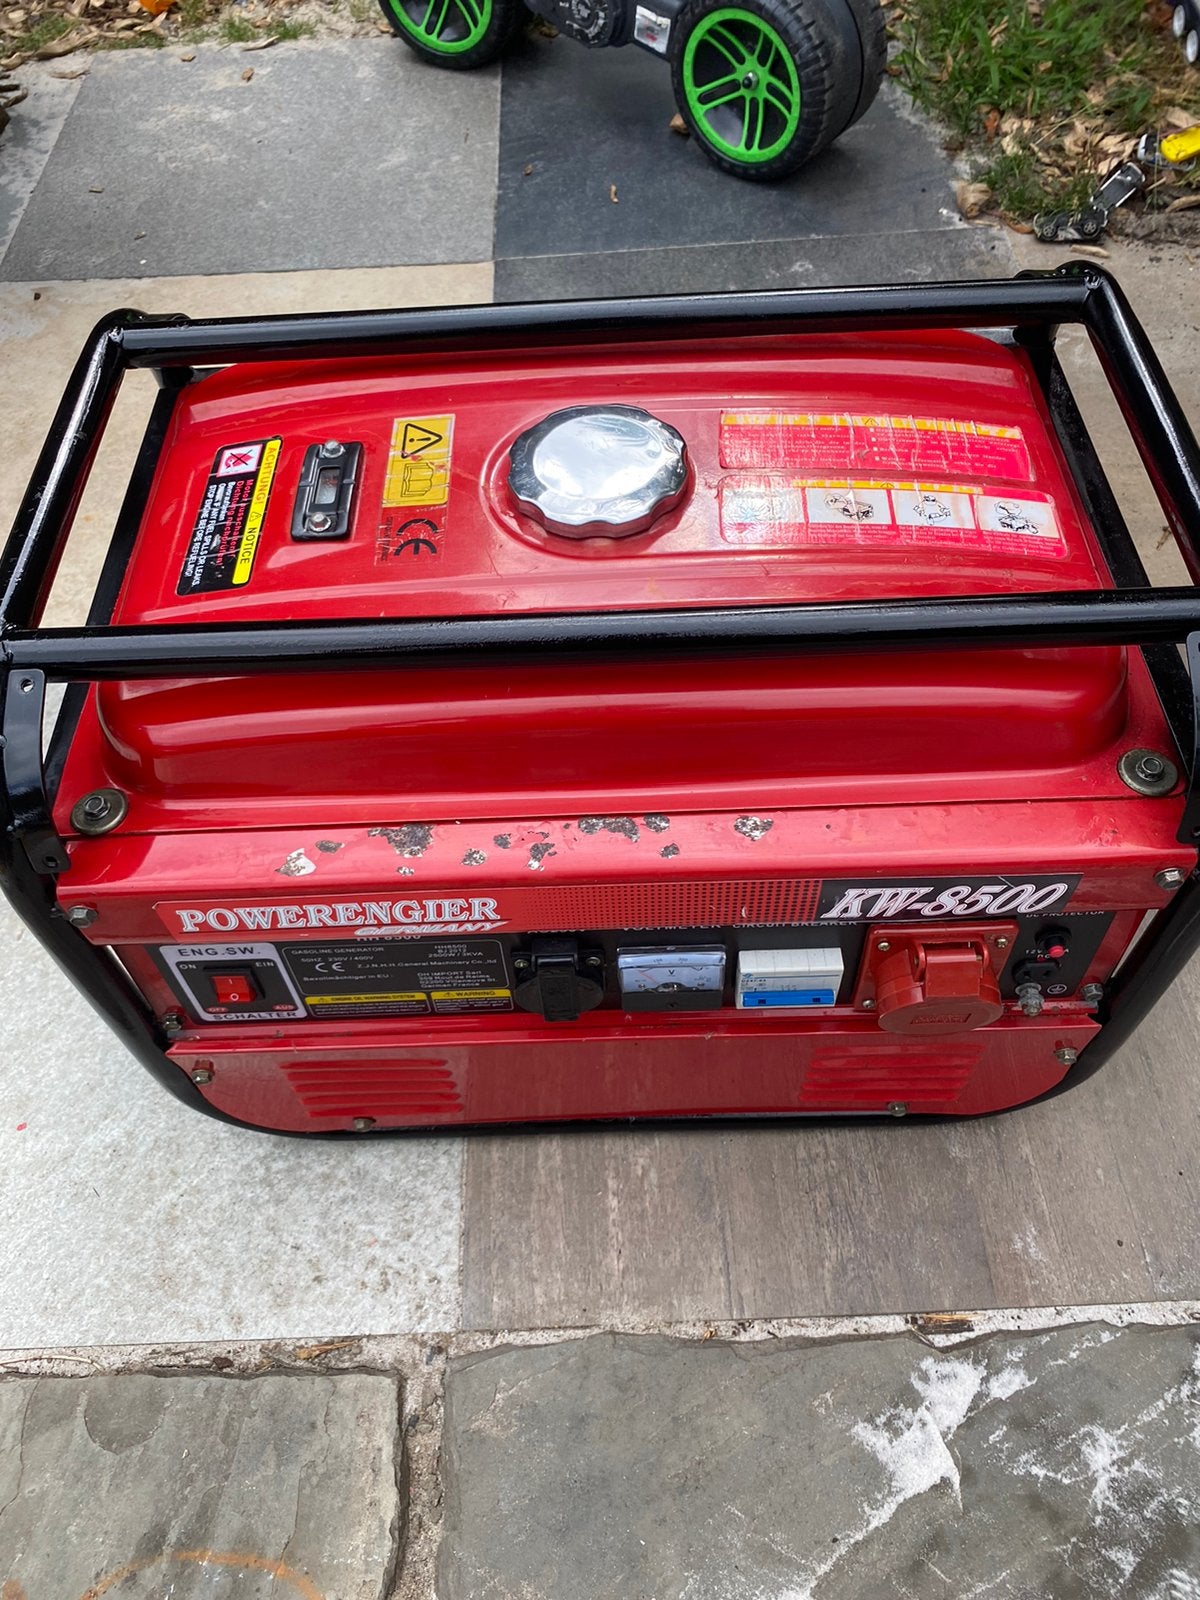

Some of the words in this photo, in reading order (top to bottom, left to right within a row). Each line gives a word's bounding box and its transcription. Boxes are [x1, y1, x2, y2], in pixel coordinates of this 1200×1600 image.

[255, 447, 277, 505] ACHTUNG!
[240, 527, 256, 564] NOTICE
[175, 897, 501, 932] POWERENGIER
[820, 882, 1068, 919] KW-8500
[213, 1011, 298, 1020] SCHALTER
